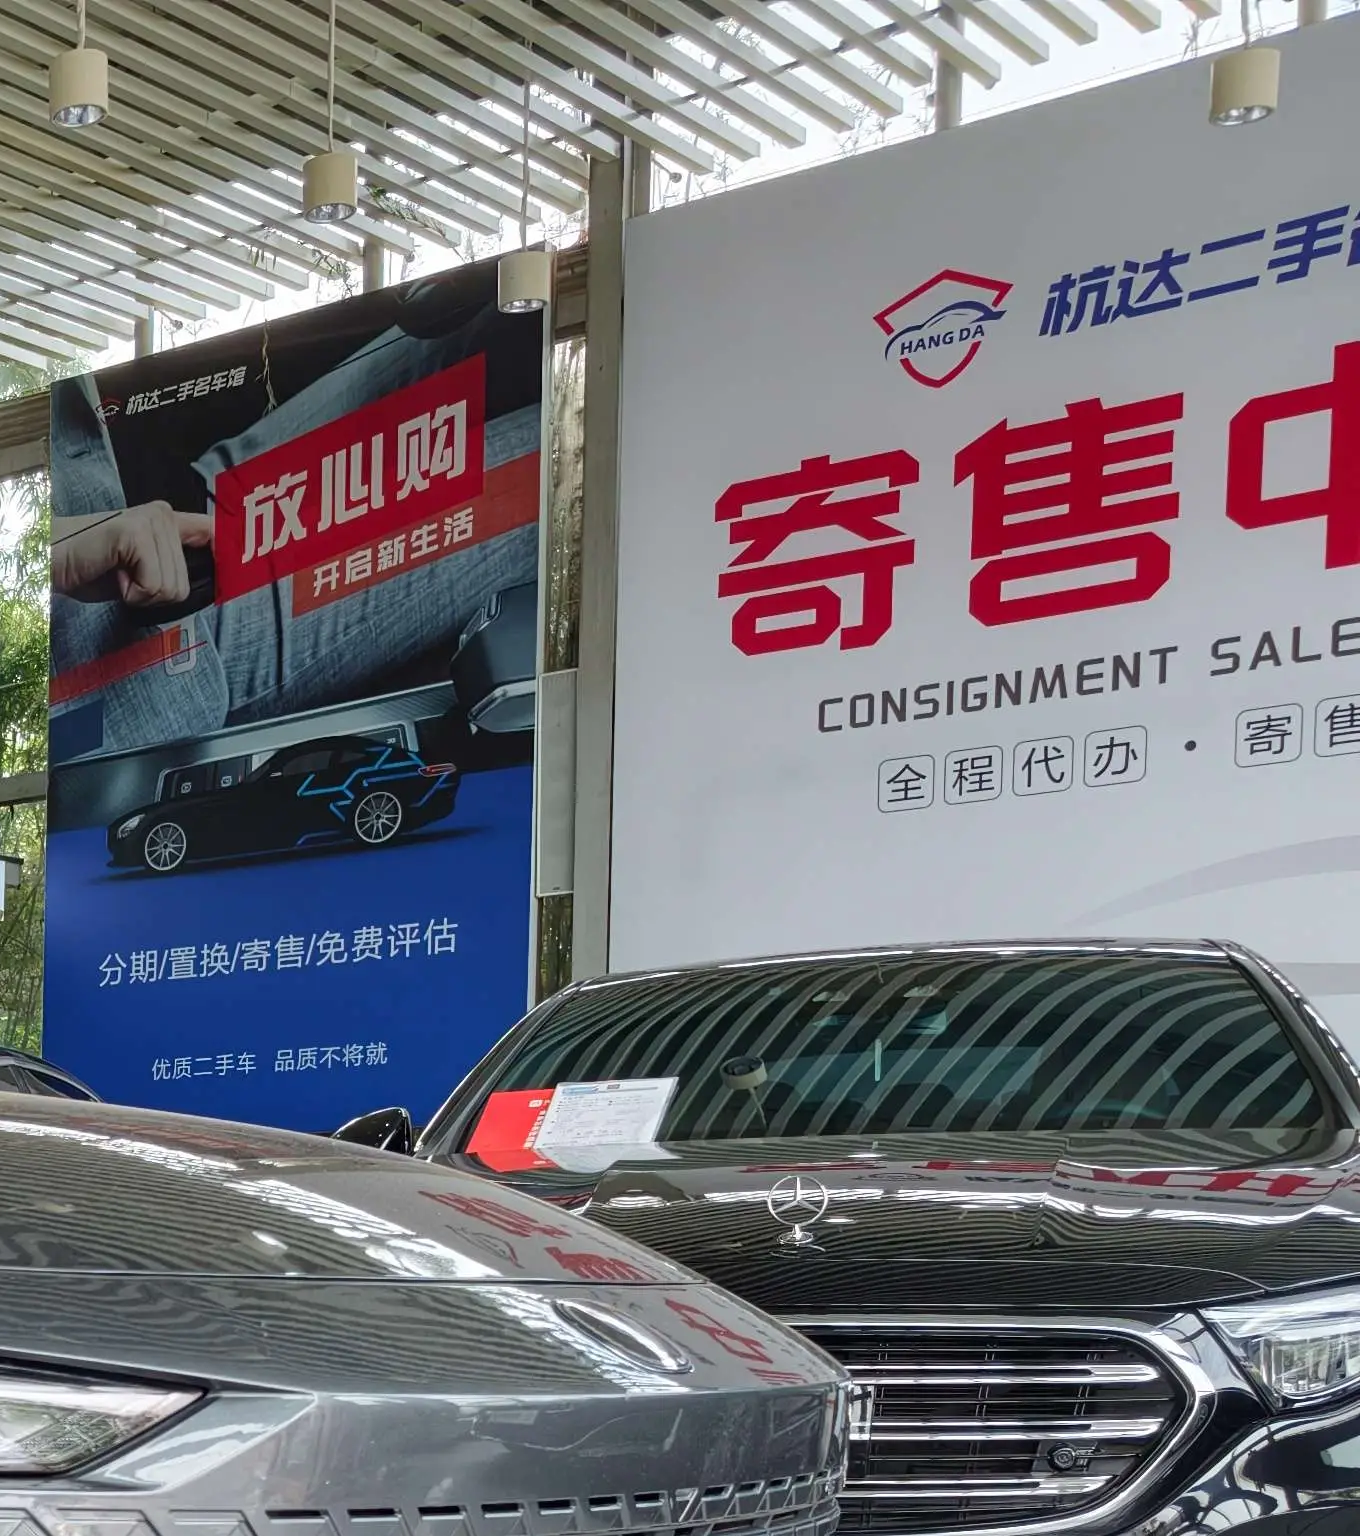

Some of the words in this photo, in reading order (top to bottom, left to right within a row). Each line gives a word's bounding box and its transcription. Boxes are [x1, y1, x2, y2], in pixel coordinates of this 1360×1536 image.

[1038, 204, 1360, 338] 杭达二手
[900, 331, 954, 355] HANG
[958, 324, 985, 343] DA
[125, 365, 247, 415] 杭达二手名车馆
[241, 399, 468, 566] 放心购
[312, 507, 474, 598] 开启新生活
[817, 645, 1178, 734] CONSIGNMENT
[1210, 616, 1360, 677] SALE
[97, 917, 460, 989] 分期/置换/寄售/免费评估
[150, 1050, 258, 1082] 优质二手车
[274, 1041, 389, 1073] 品质不将就
